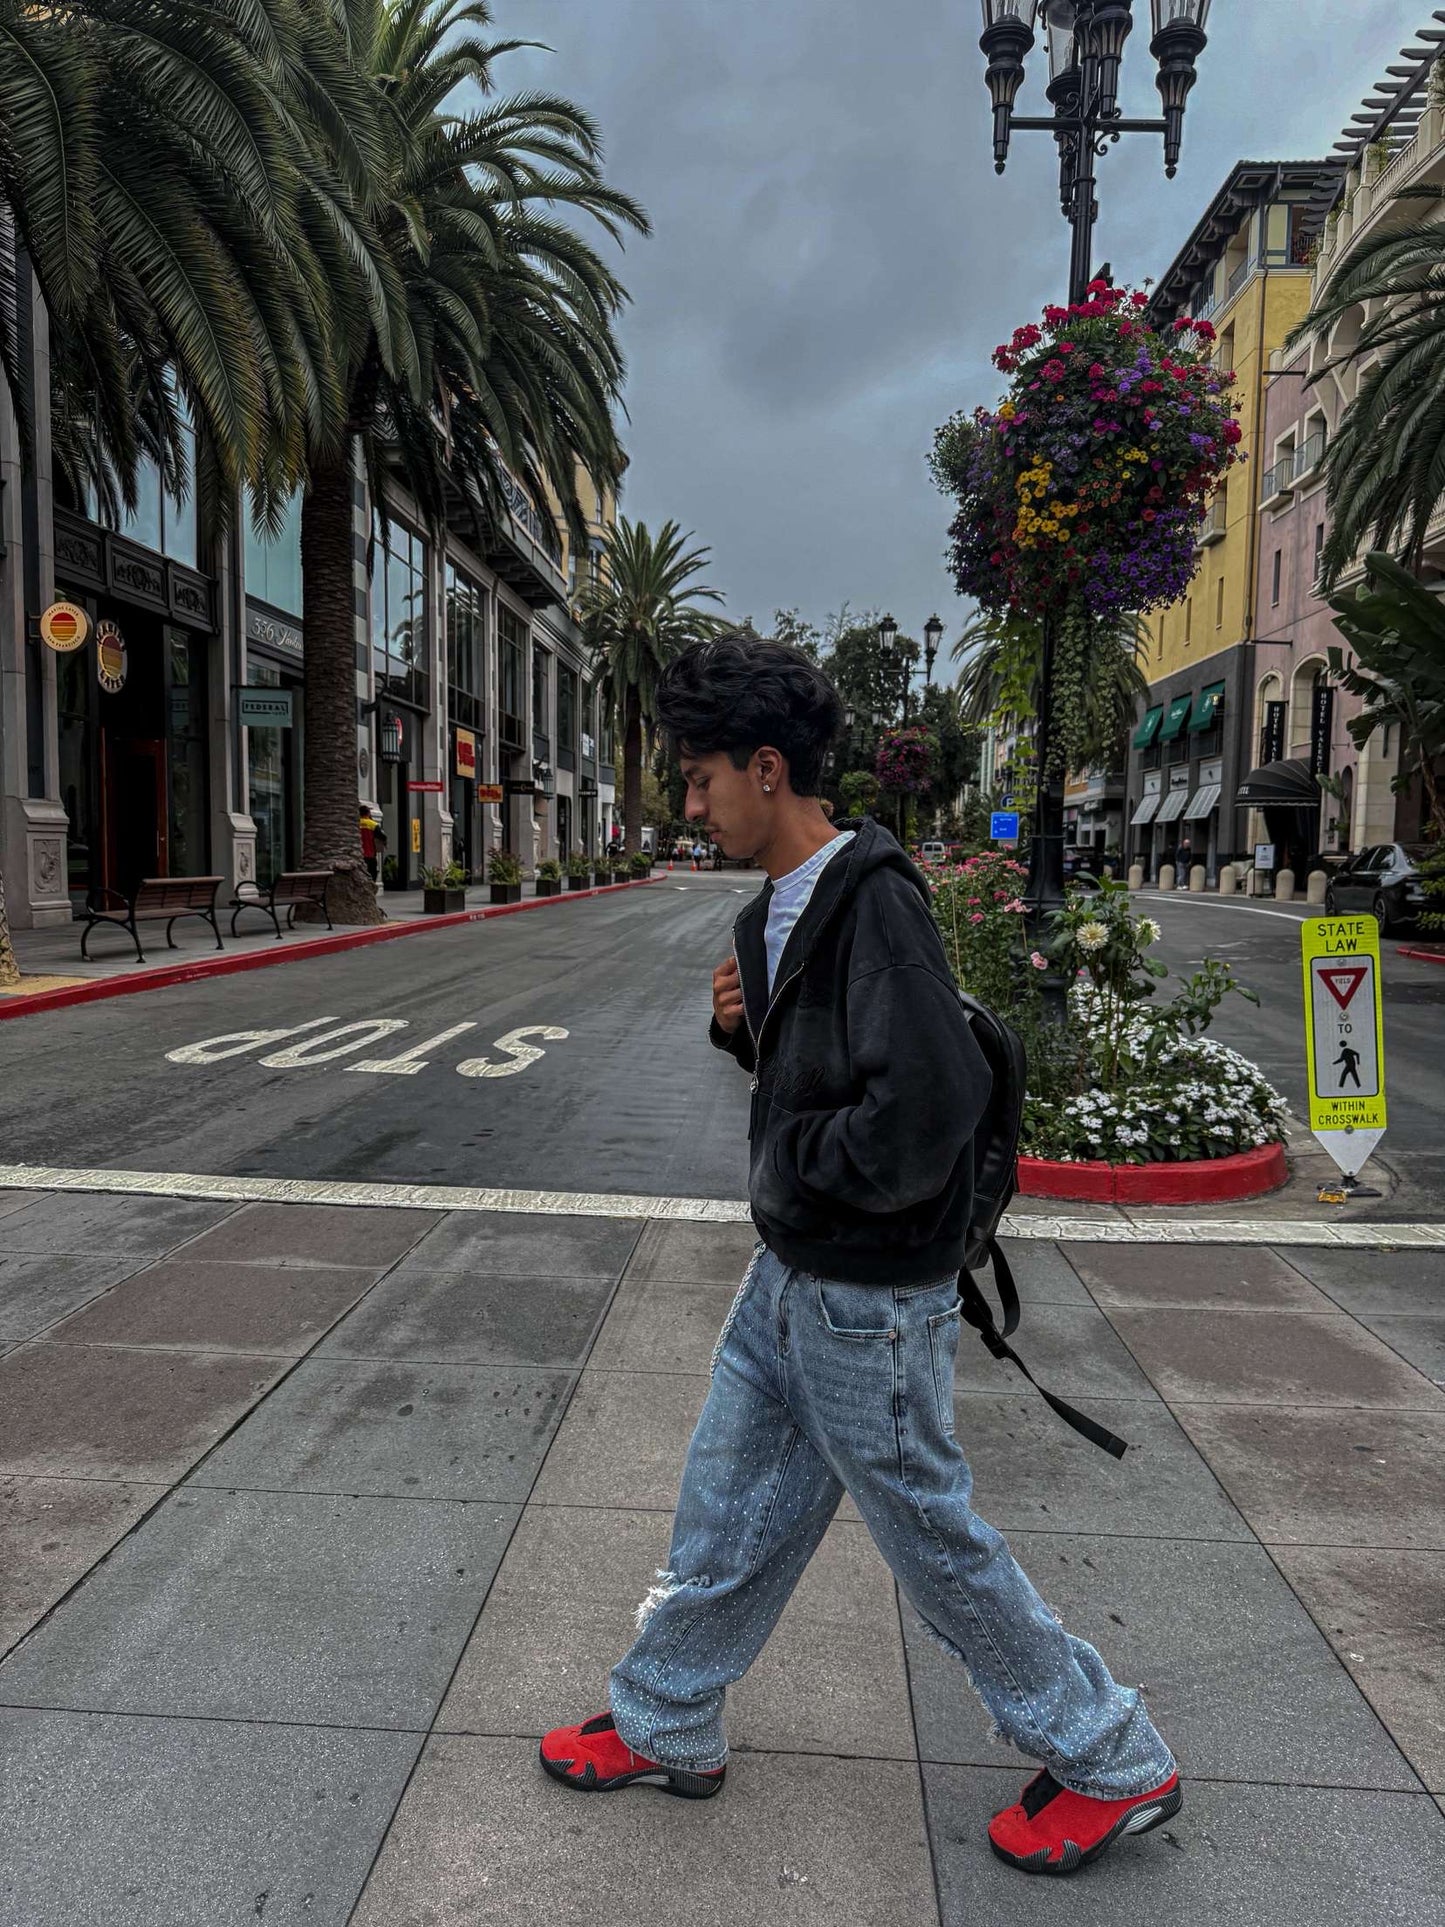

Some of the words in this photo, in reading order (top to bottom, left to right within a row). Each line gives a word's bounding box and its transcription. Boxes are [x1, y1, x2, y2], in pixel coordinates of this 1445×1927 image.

[245, 703, 286, 711] FEDERAL
[1317, 922, 1365, 937] STATE
[1325, 938, 1357, 952] LAW
[1335, 977, 1351, 985] YIELD
[1337, 1023, 1352, 1034] TO
[165, 1016, 569, 1078] STOP
[1331, 1100, 1365, 1111] WITHIN
[1318, 1113, 1378, 1125] CROSSWALK
